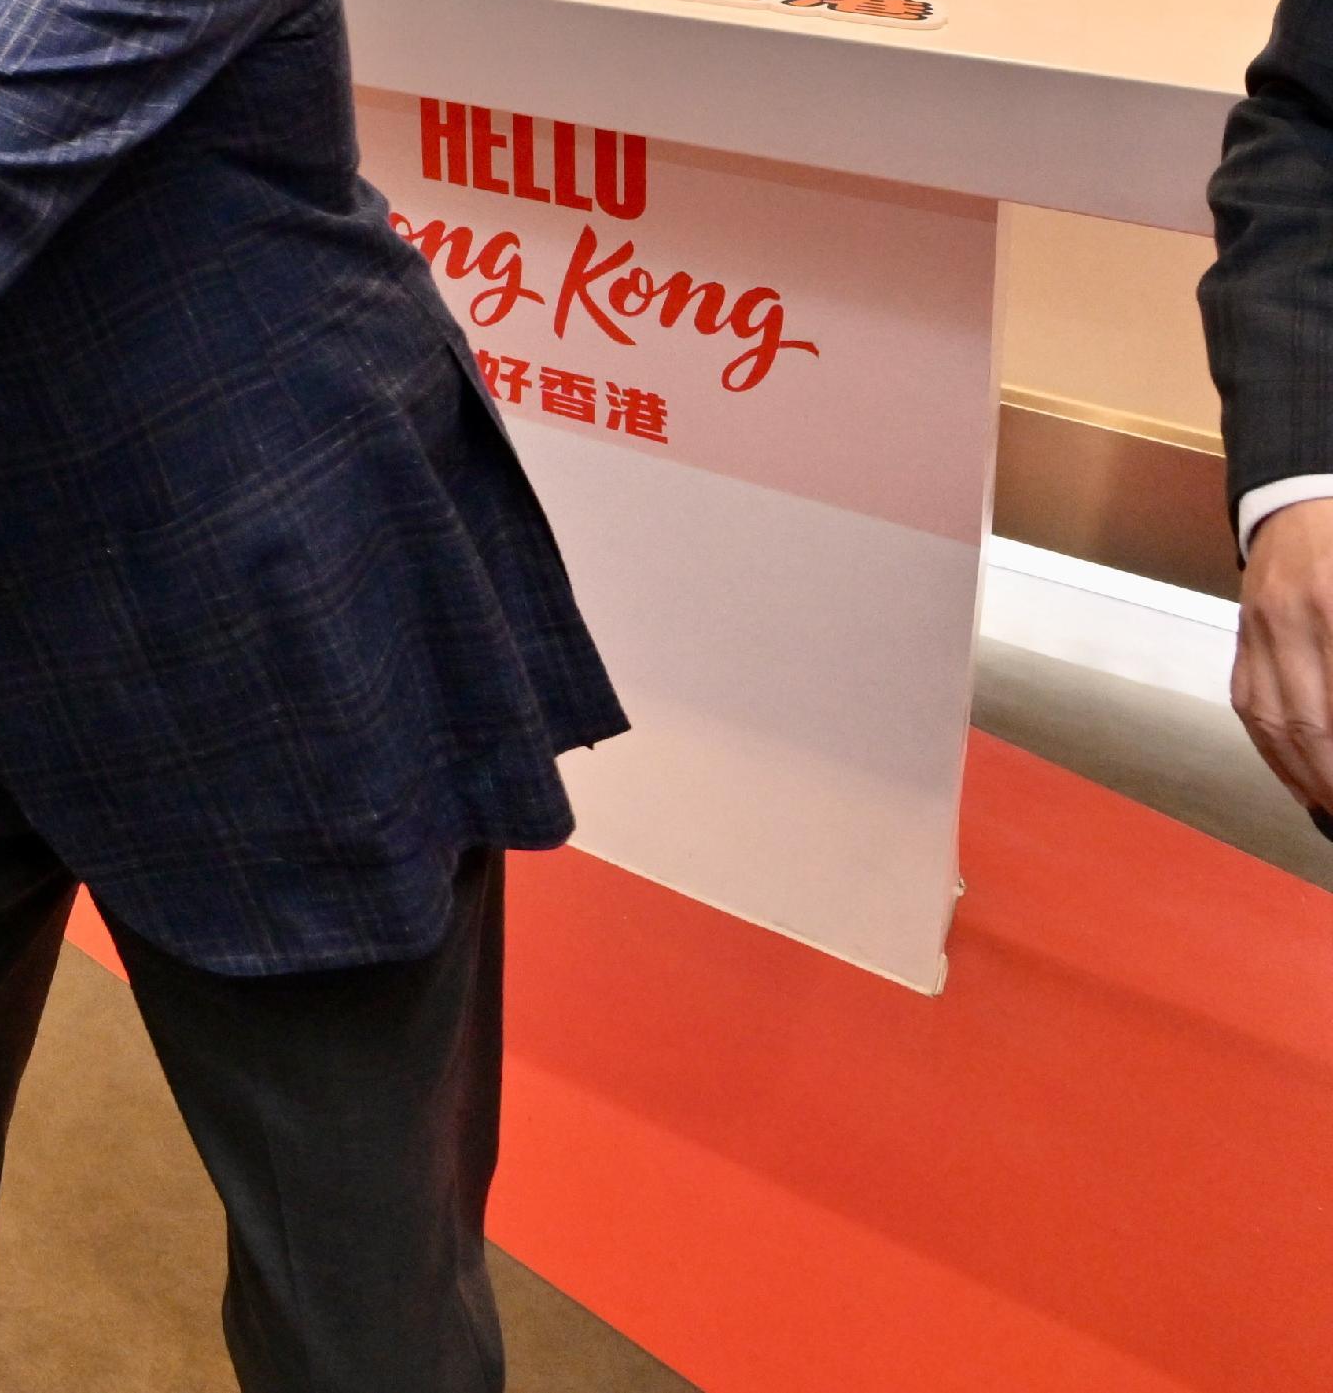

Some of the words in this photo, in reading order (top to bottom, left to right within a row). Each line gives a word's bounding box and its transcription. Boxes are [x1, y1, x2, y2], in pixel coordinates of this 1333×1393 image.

[420, 97, 647, 221] HELLO
[388, 212, 545, 327] ong
[553, 223, 820, 393] Kong
[475, 349, 669, 444] 好香港
